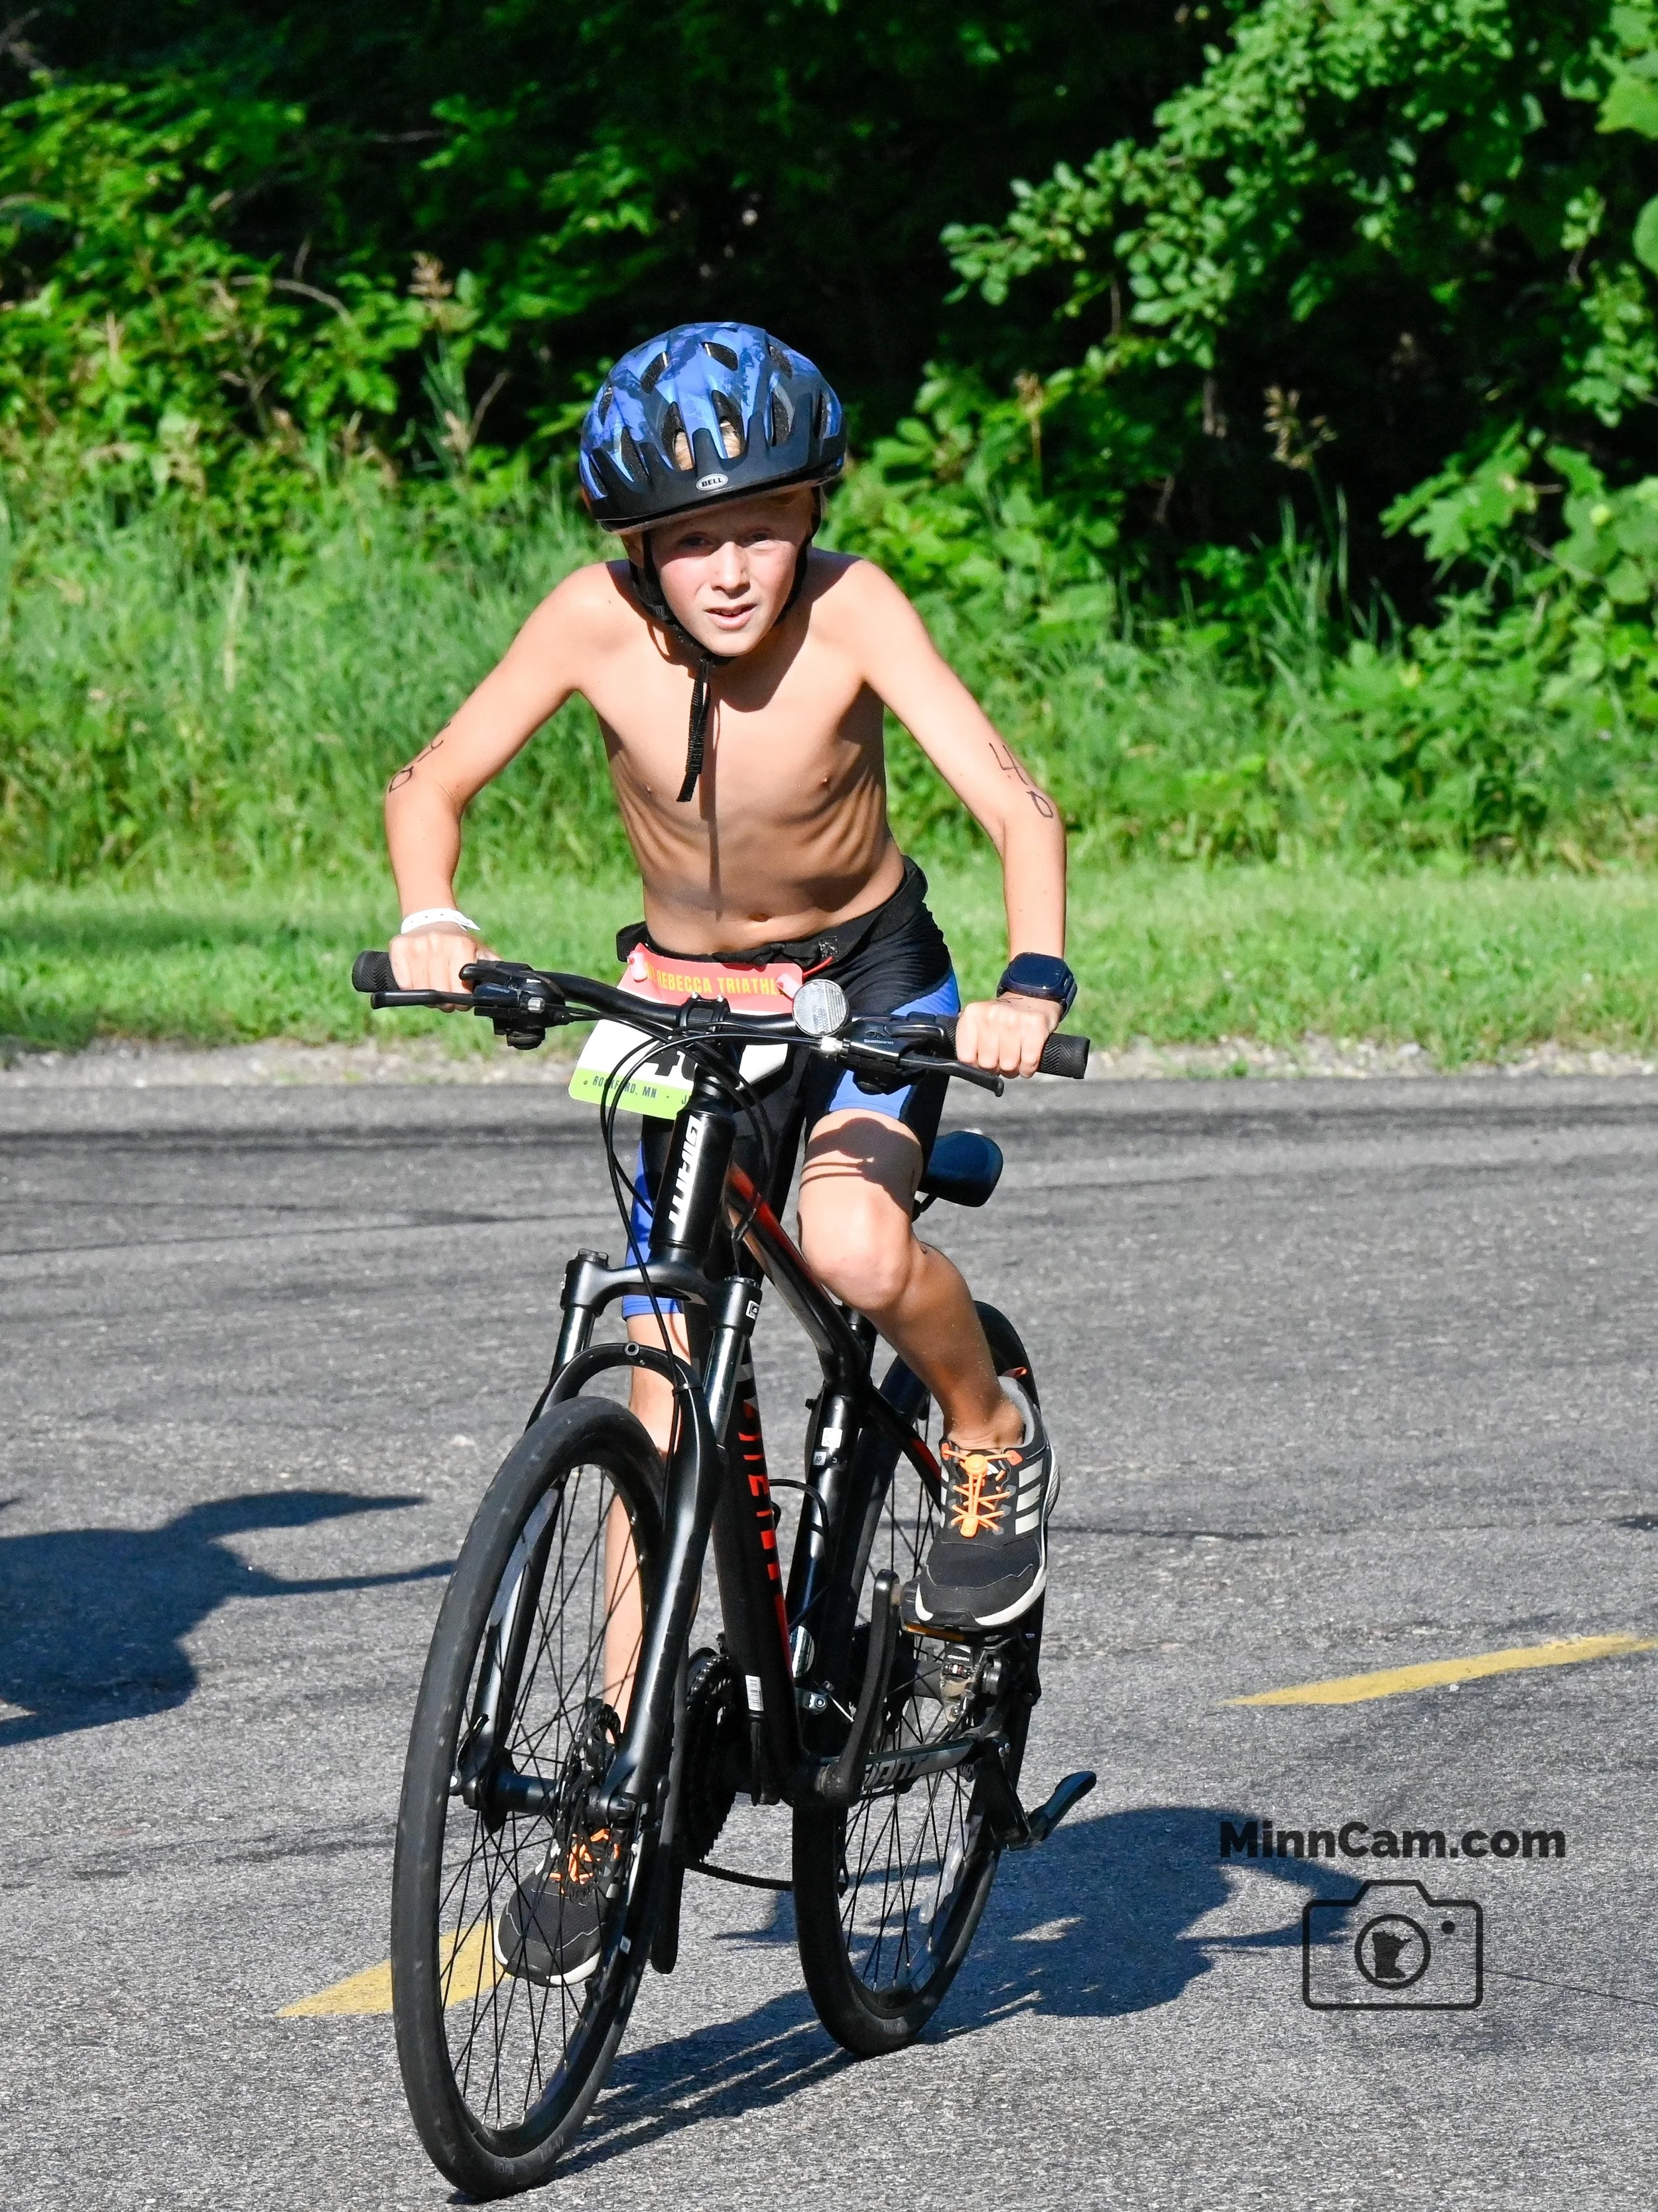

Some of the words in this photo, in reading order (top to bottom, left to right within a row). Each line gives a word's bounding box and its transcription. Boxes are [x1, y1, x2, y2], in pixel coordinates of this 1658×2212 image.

[701, 478, 723, 488] BELL
[657, 970, 712, 994] REBECCA
[716, 976, 779, 996] TRIATHL
[642, 1086, 657, 1099] MN
[668, 1114, 705, 1227] GIANT
